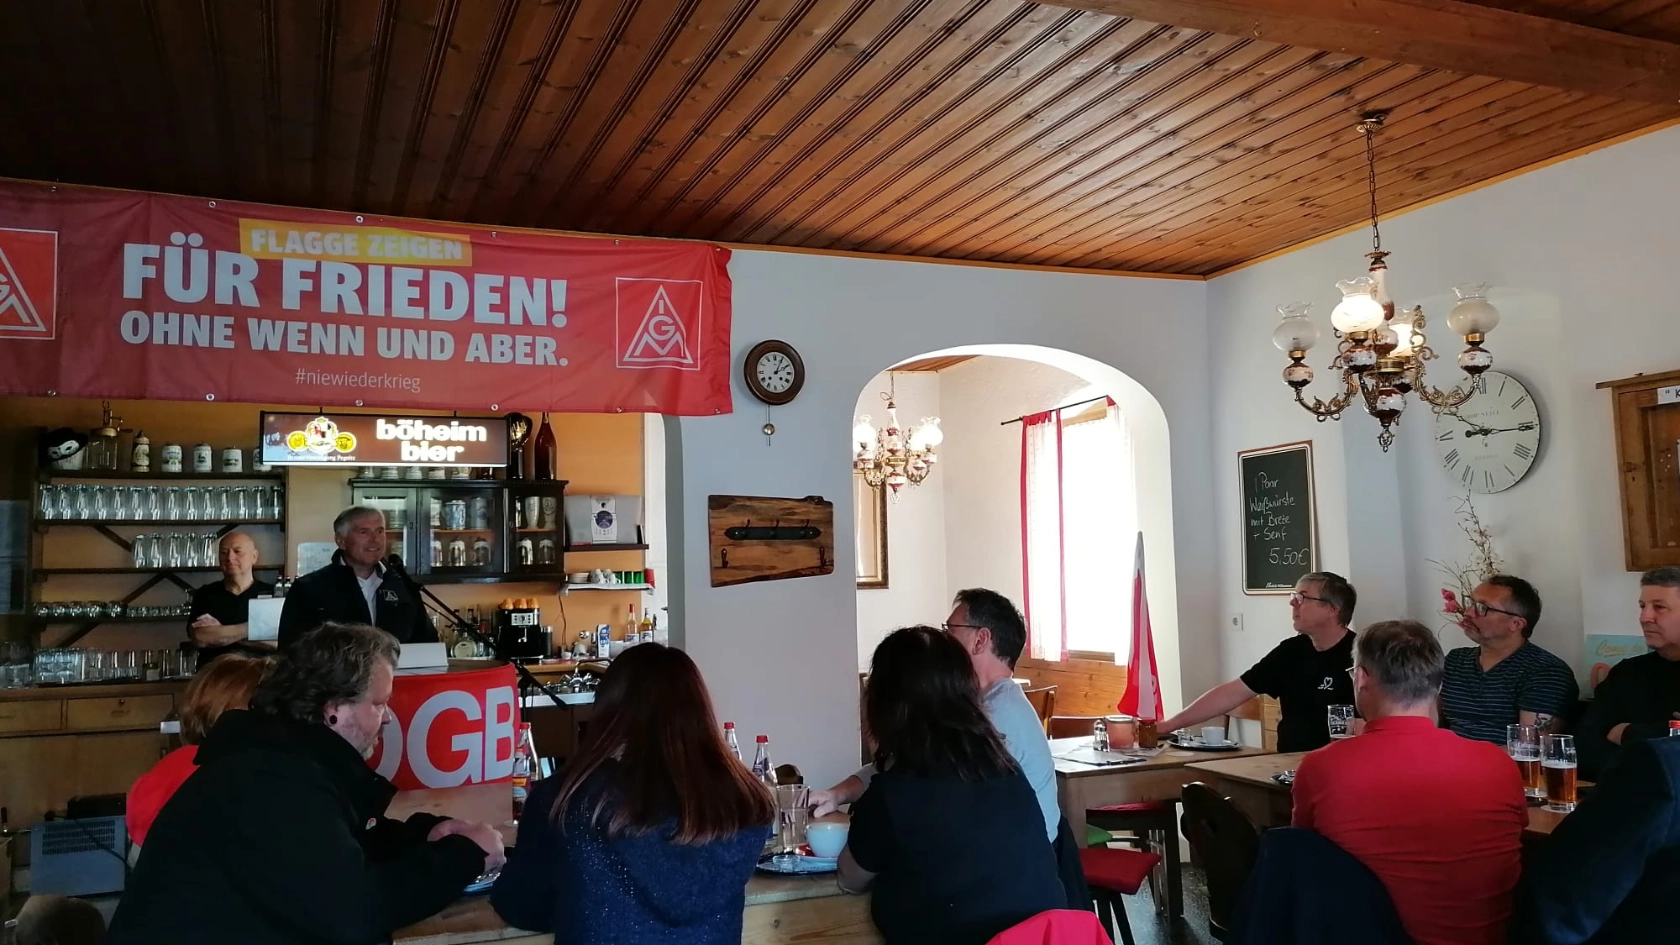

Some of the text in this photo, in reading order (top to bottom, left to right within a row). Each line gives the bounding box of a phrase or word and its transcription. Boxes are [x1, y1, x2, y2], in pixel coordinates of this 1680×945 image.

[251, 229, 463, 262] FLAGGE ZEIGEN
[122, 231, 568, 328] FÜR FRIEDEN!
[120, 310, 569, 367] OHNE WENN UND ABER.
[295, 367, 421, 393] #niewiederkrieg
[376, 419, 487, 442] böheim
[401, 441, 465, 462] bier
[1250, 516, 1263, 527] mit
[1263, 526, 1287, 541] Senf
